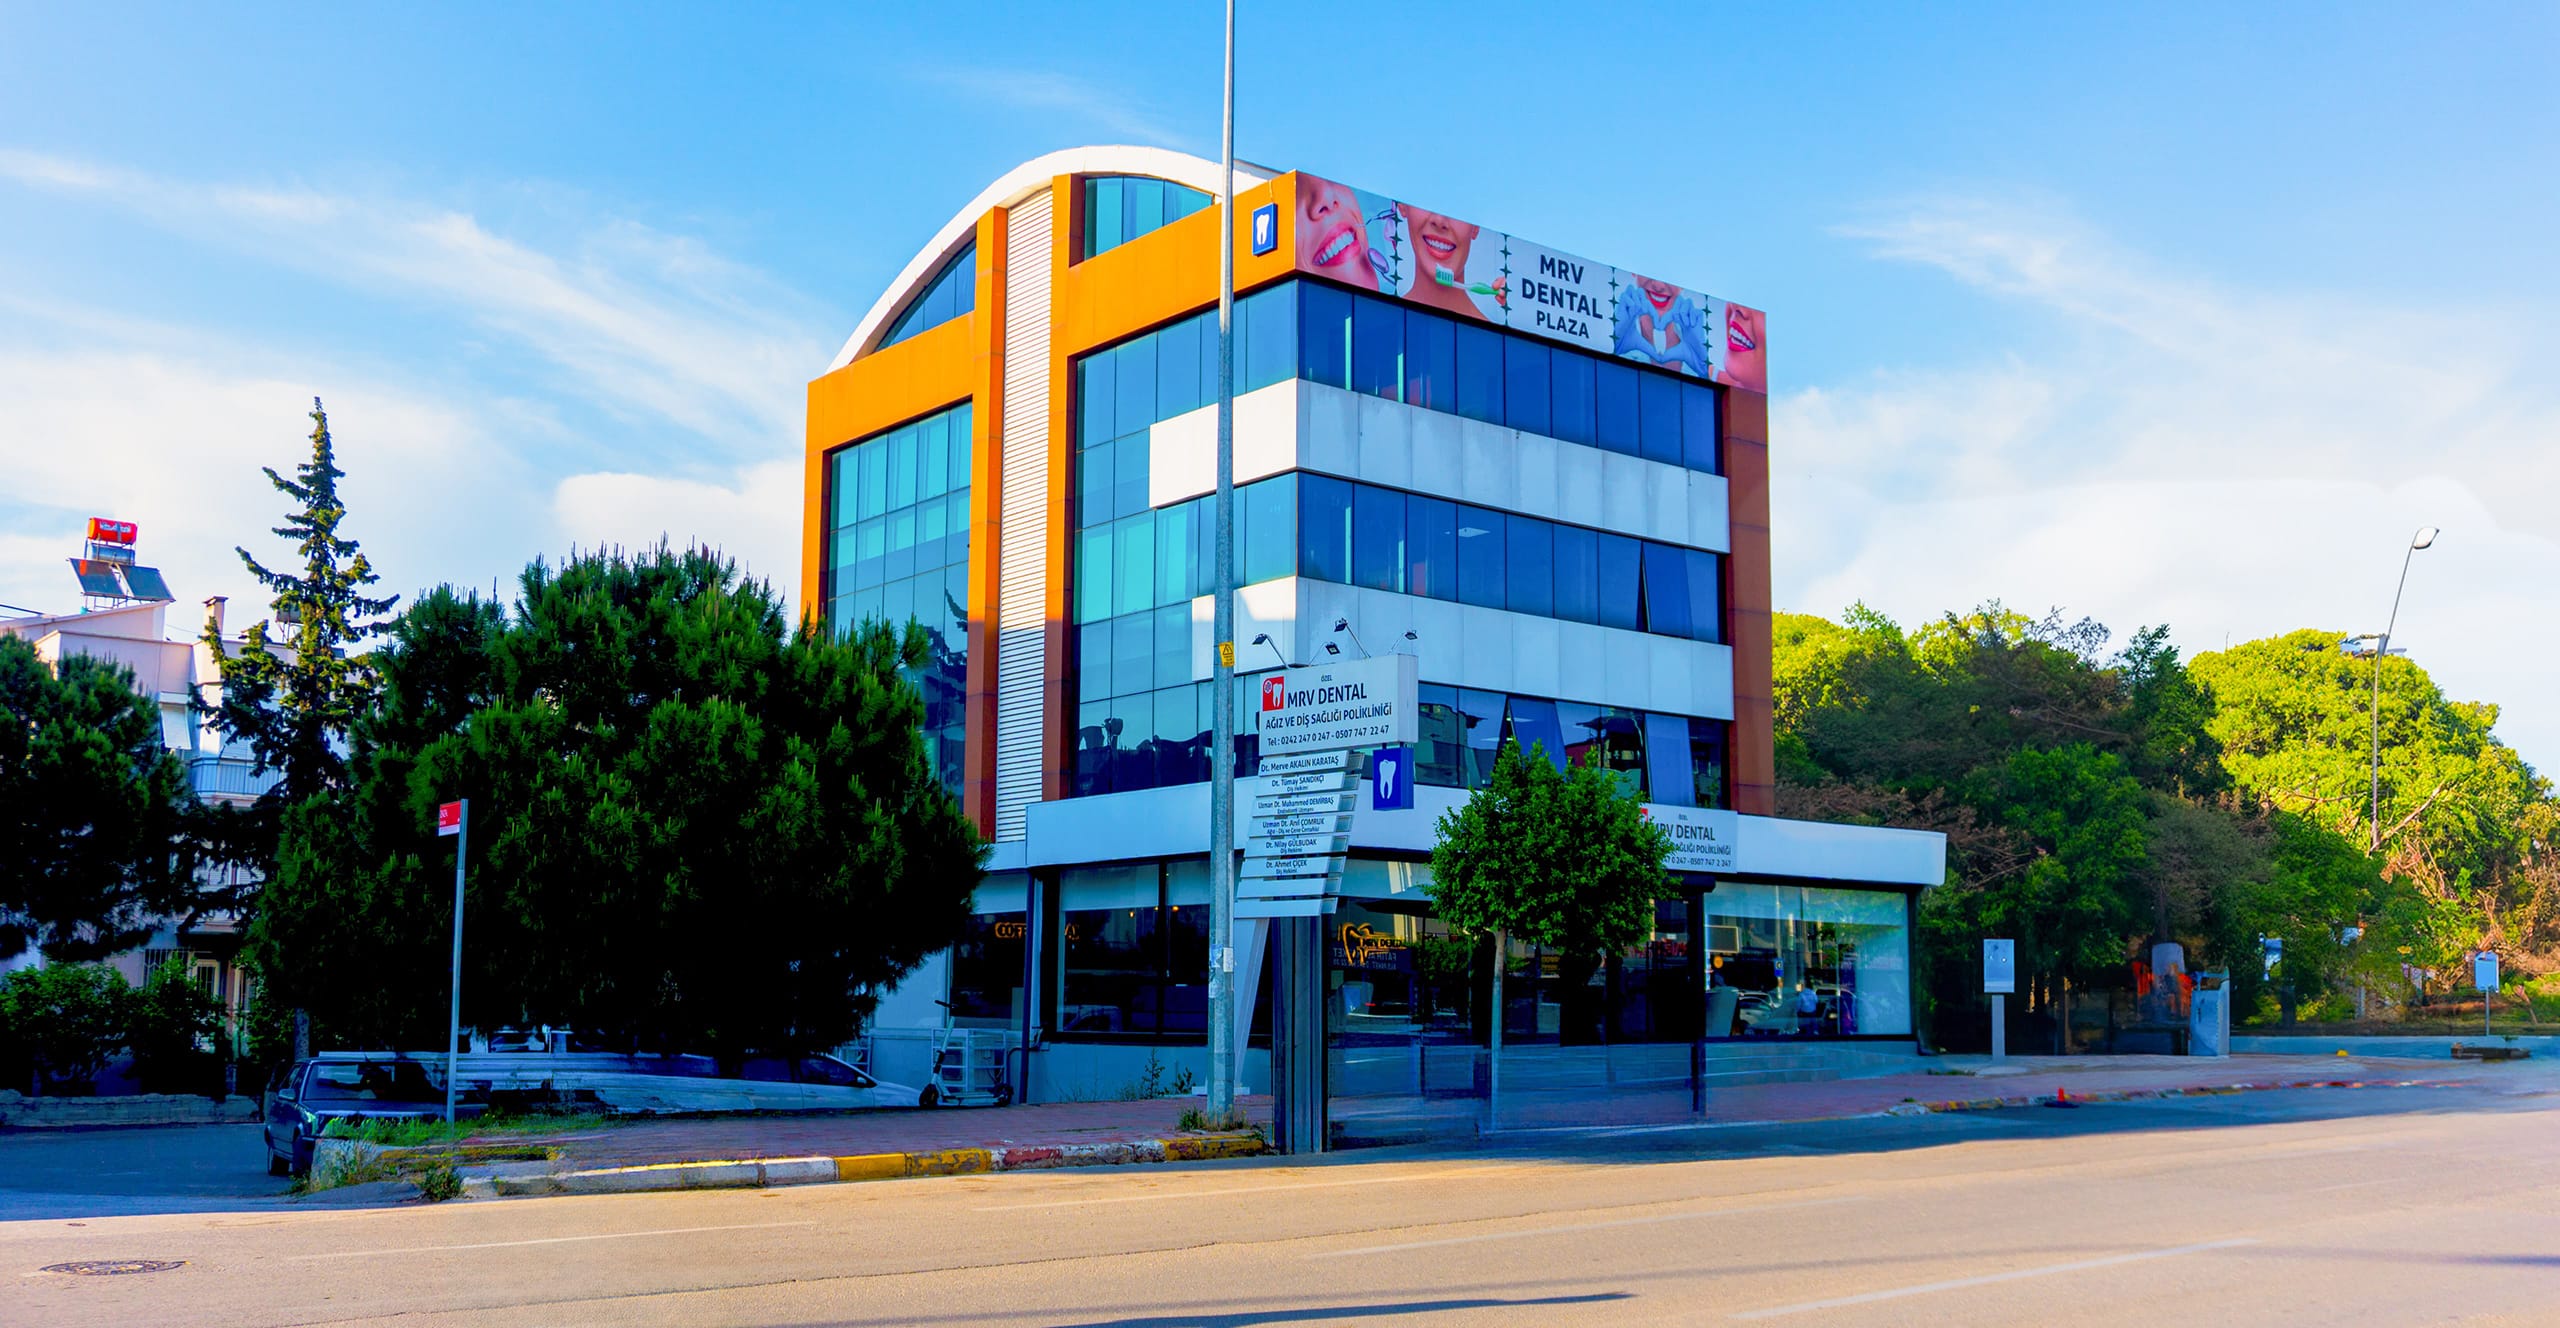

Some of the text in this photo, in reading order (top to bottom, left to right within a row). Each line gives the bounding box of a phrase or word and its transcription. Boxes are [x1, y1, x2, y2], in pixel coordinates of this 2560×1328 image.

[1540, 254, 1584, 284] MRV
[1521, 278, 1603, 319] DENTAL
[1536, 310, 1590, 339] PLAZA
[1287, 683, 1367, 708] MRV DENTAL
[1265, 702, 1392, 730] AĞIZ VE DİŞ SAĞLIĞI POLİKLİNİĞİ
[1280, 735, 1297, 745] 0242
[1298, 733, 1311, 743] 247
[1311, 733, 1317, 742] 0
[1317, 731, 1330, 741] 247
[1335, 729, 1353, 740] 0507
[1354, 727, 1367, 737] 747
[1370, 726, 1379, 736] 22
[1380, 725, 1390, 734] 47
[1270, 762, 1289, 771] Merve
[1289, 758, 1311, 769] AKALIN
[1311, 755, 1339, 766] KARATAŞ
[1281, 777, 1298, 787] Tümay
[1676, 824, 1716, 841] DENTAL
